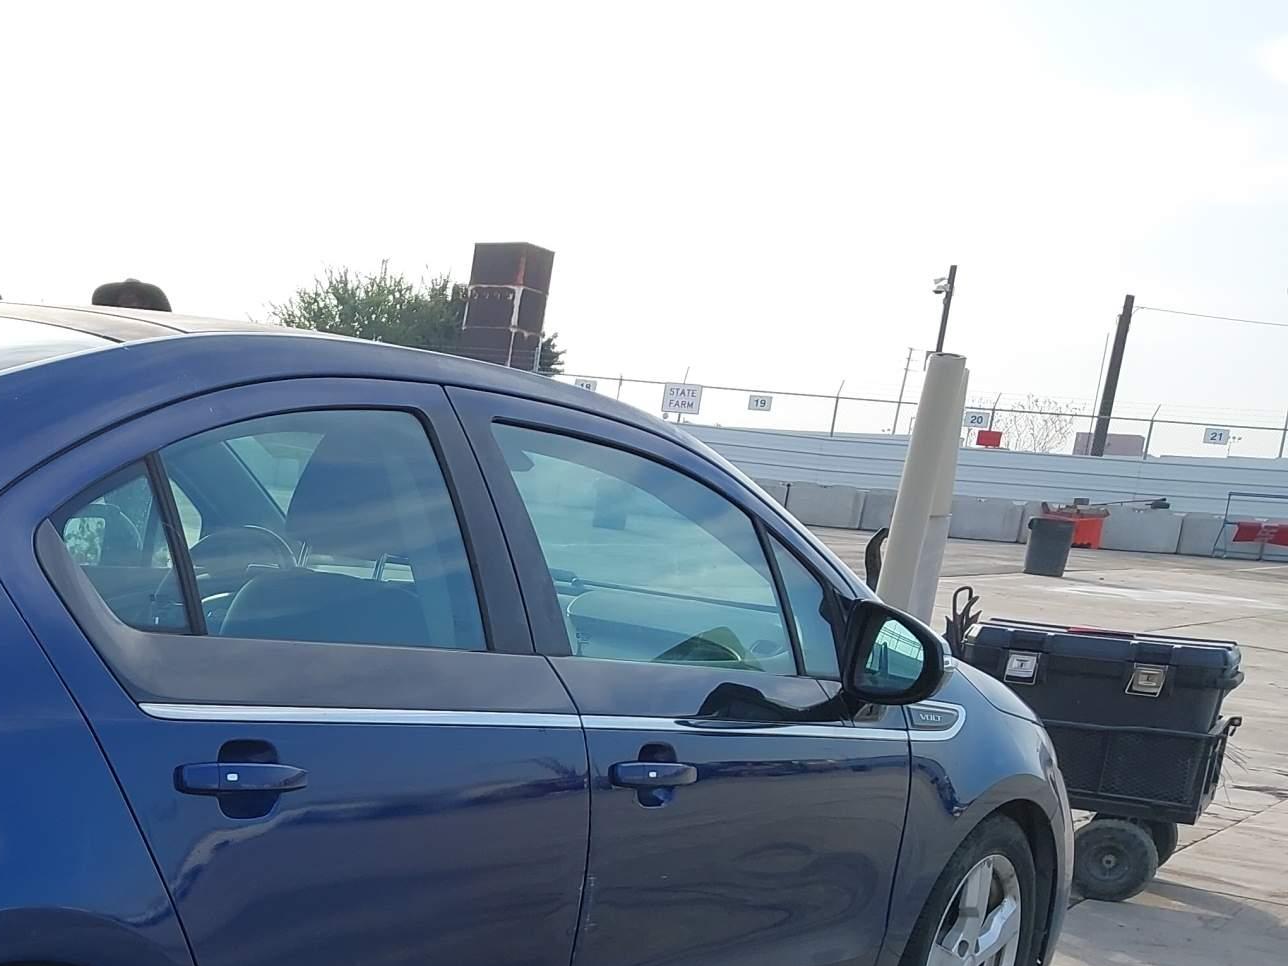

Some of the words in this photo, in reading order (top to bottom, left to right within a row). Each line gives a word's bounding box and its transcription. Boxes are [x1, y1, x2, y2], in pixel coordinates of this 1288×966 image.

[669, 387, 697, 398] STATE
[668, 399, 694, 409] FARM
[754, 399, 767, 408] 19
[970, 415, 984, 425] 20
[1210, 431, 1224, 441] 21
[919, 713, 944, 722] VOLT
